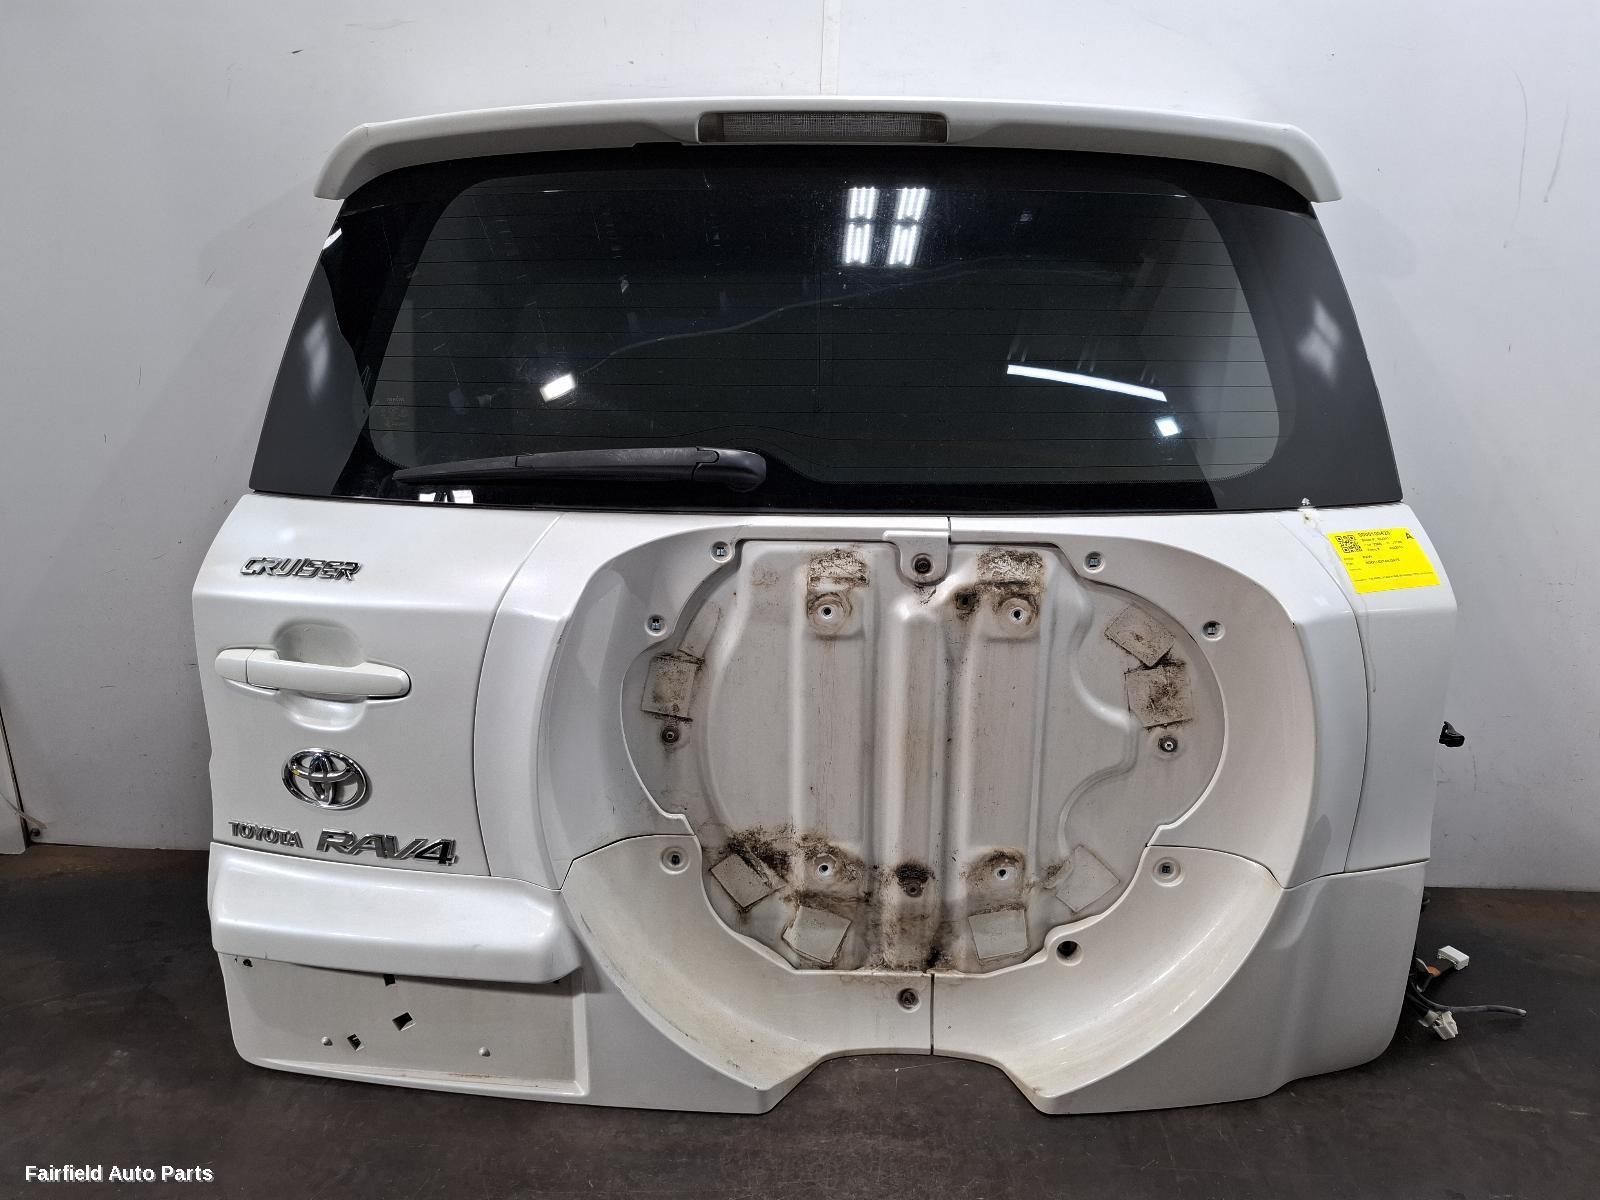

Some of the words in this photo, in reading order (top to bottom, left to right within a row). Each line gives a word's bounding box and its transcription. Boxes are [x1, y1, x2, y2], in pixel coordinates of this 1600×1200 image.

[240, 557, 361, 580] CRUISER
[228, 821, 304, 849] TOYOTA
[315, 828, 458, 866] RAV4
